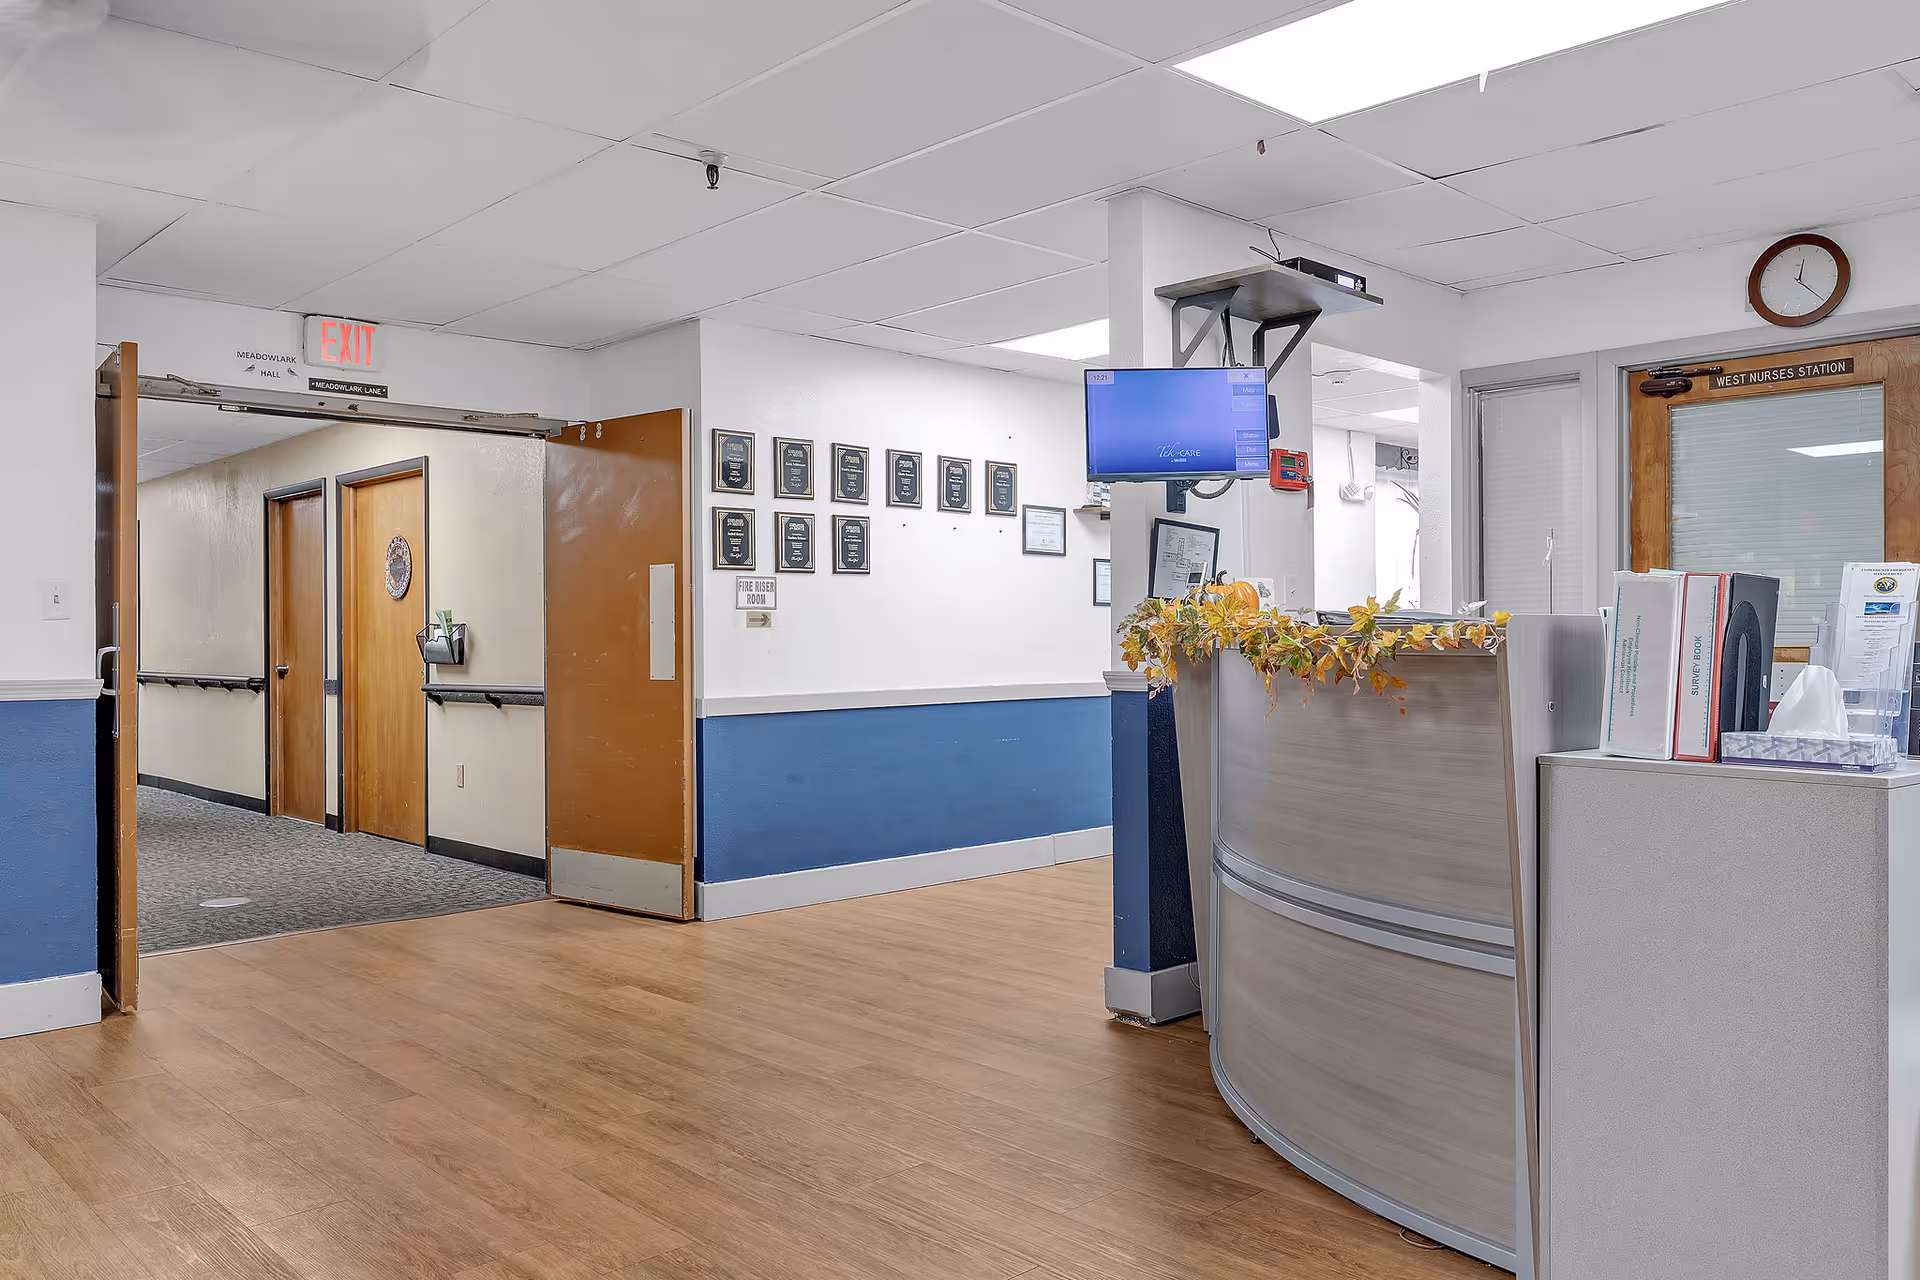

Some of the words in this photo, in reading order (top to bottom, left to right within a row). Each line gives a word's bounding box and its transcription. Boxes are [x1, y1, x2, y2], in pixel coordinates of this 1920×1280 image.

[321, 320, 375, 366] EXIT
[236, 351, 297, 364] MEADOWLARK
[260, 369, 281, 379] HALL
[1716, 373, 1746, 387] WEST
[1749, 367, 1794, 383] NURSES
[1798, 361, 1846, 377] STATION
[315, 381, 362, 393] MEADOWLARK
[364, 387, 382, 395] LANE
[738, 580, 753, 592] FIRE
[754, 581, 775, 593] RISER
[746, 593, 766, 605] ROOM
[1693, 635, 1702, 660] BOOK
[1691, 662, 1700, 696] SURVEY
